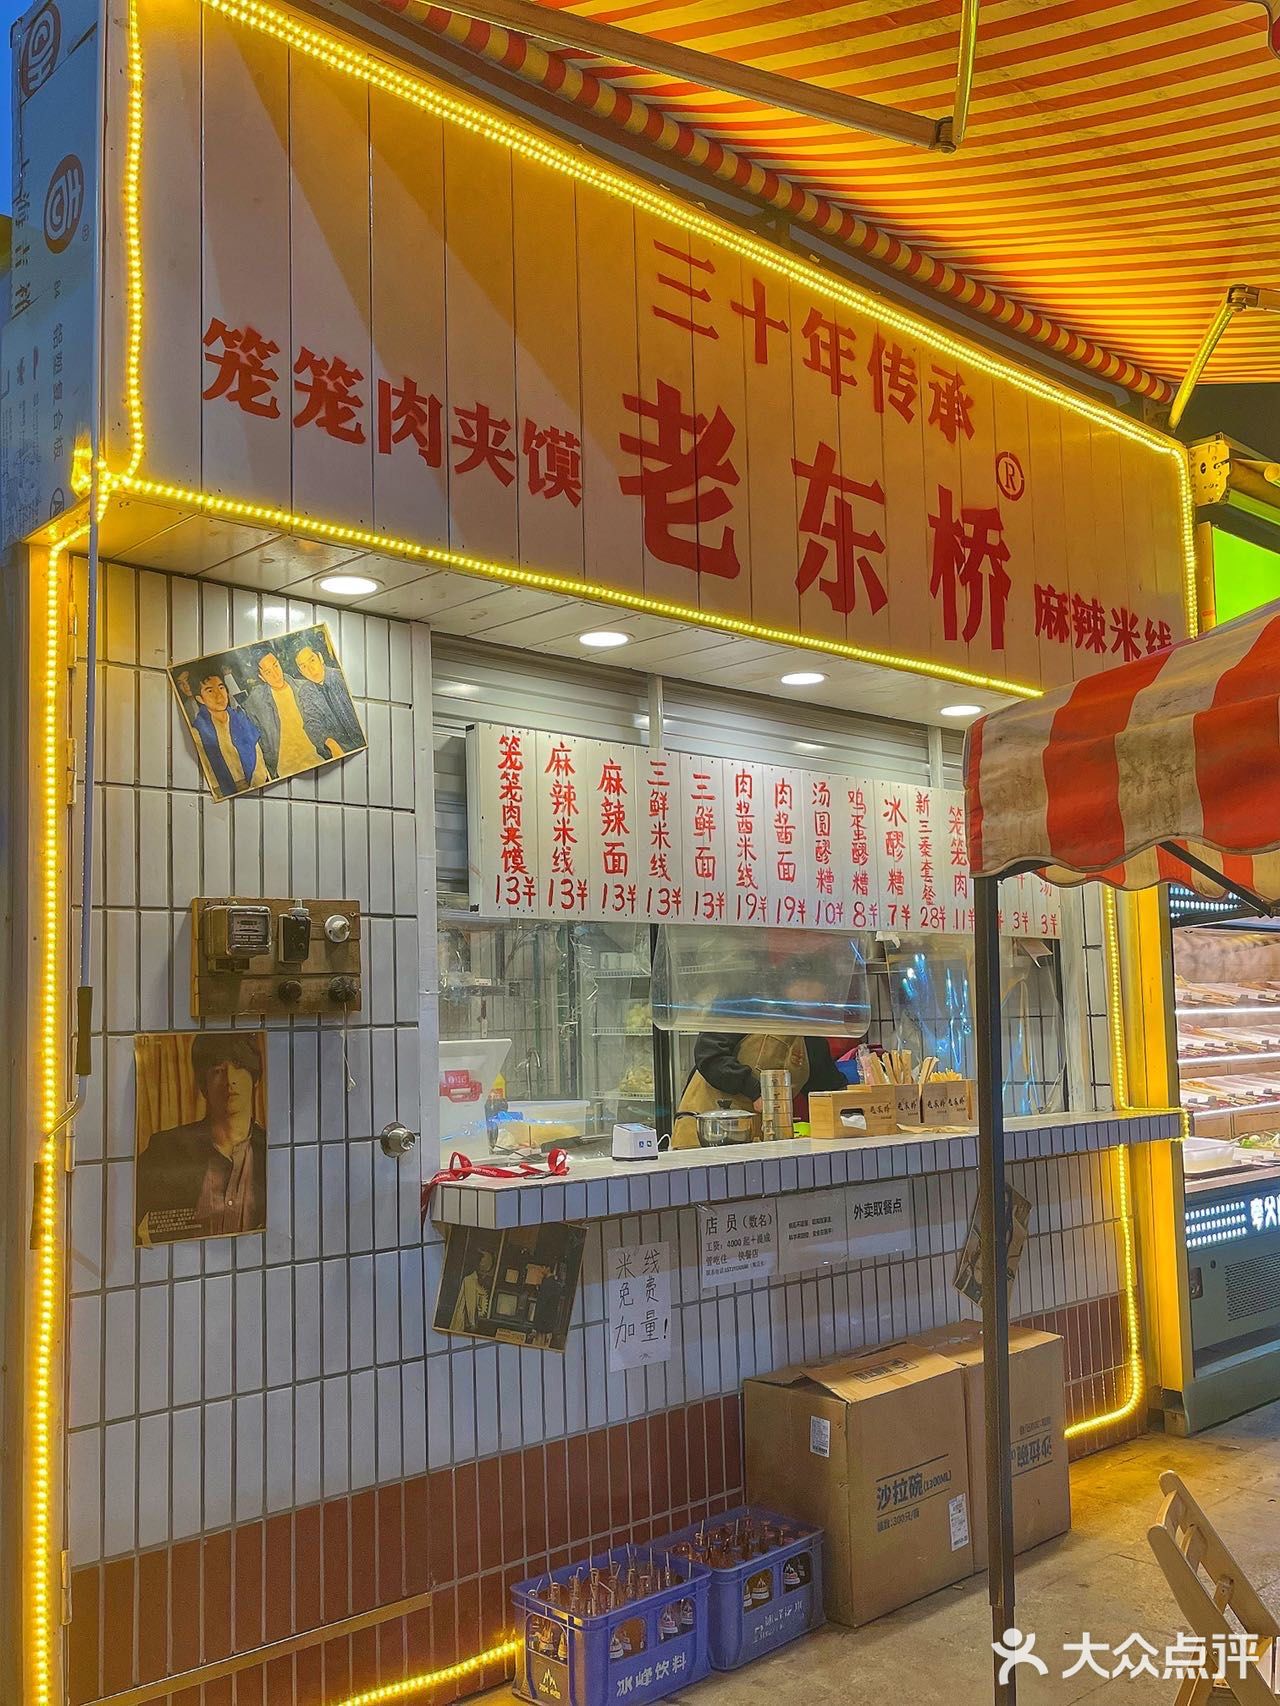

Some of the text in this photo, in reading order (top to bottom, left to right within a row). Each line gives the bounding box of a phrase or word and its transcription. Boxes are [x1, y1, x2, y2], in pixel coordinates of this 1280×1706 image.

[653, 240, 975, 443] 三十年传承
[202, 317, 583, 507] 笼笼肉夹馍
[618, 379, 1012, 650] 老东桥
[1034, 584, 1172, 662] 麻辣米线
[497, 735, 530, 875] 笼笼肉夹馍
[545, 741, 579, 876] 麻辣米线
[597, 757, 630, 877] 麻辣面
[647, 761, 673, 882] 三鲜米线
[690, 772, 717, 881] 三鲜面
[735, 769, 759, 890] 肉酱米线
[774, 777, 796, 884] 肉酱面
[812, 781, 835, 895] 汤圆醪糟
[848, 787, 870, 897] 鸡蛋醪糟
[883, 795, 908, 896] 冰醪糟
[615, 1248, 661, 1281] 米线
[853, 1198, 903, 1221] 外卖取餐点
[616, 1276, 660, 1309] 免费
[616, 1652, 687, 1698] 冰峰饮料
